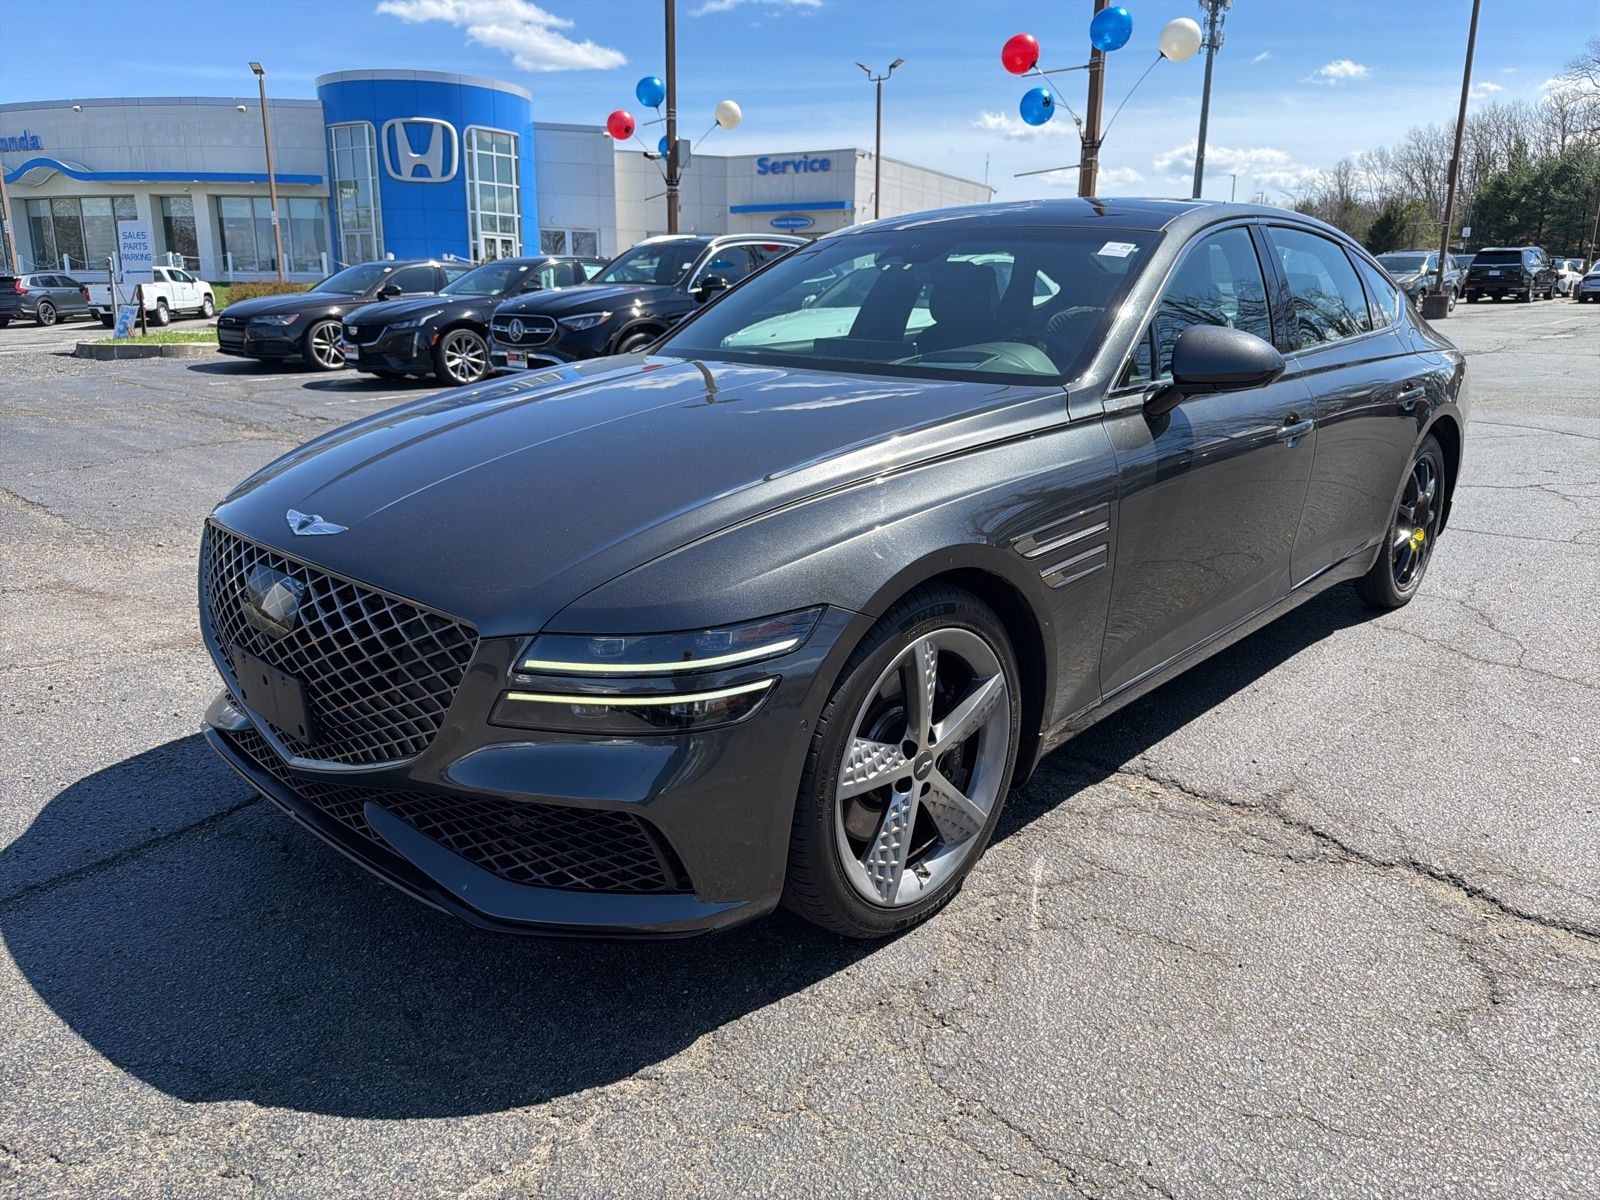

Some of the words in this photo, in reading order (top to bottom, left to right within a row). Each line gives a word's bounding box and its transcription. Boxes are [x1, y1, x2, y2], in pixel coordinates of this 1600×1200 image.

[757, 154, 832, 176] Service
[122, 231, 147, 240] SALES
[123, 242, 148, 251] PARTS
[121, 253, 152, 262] PARKING
